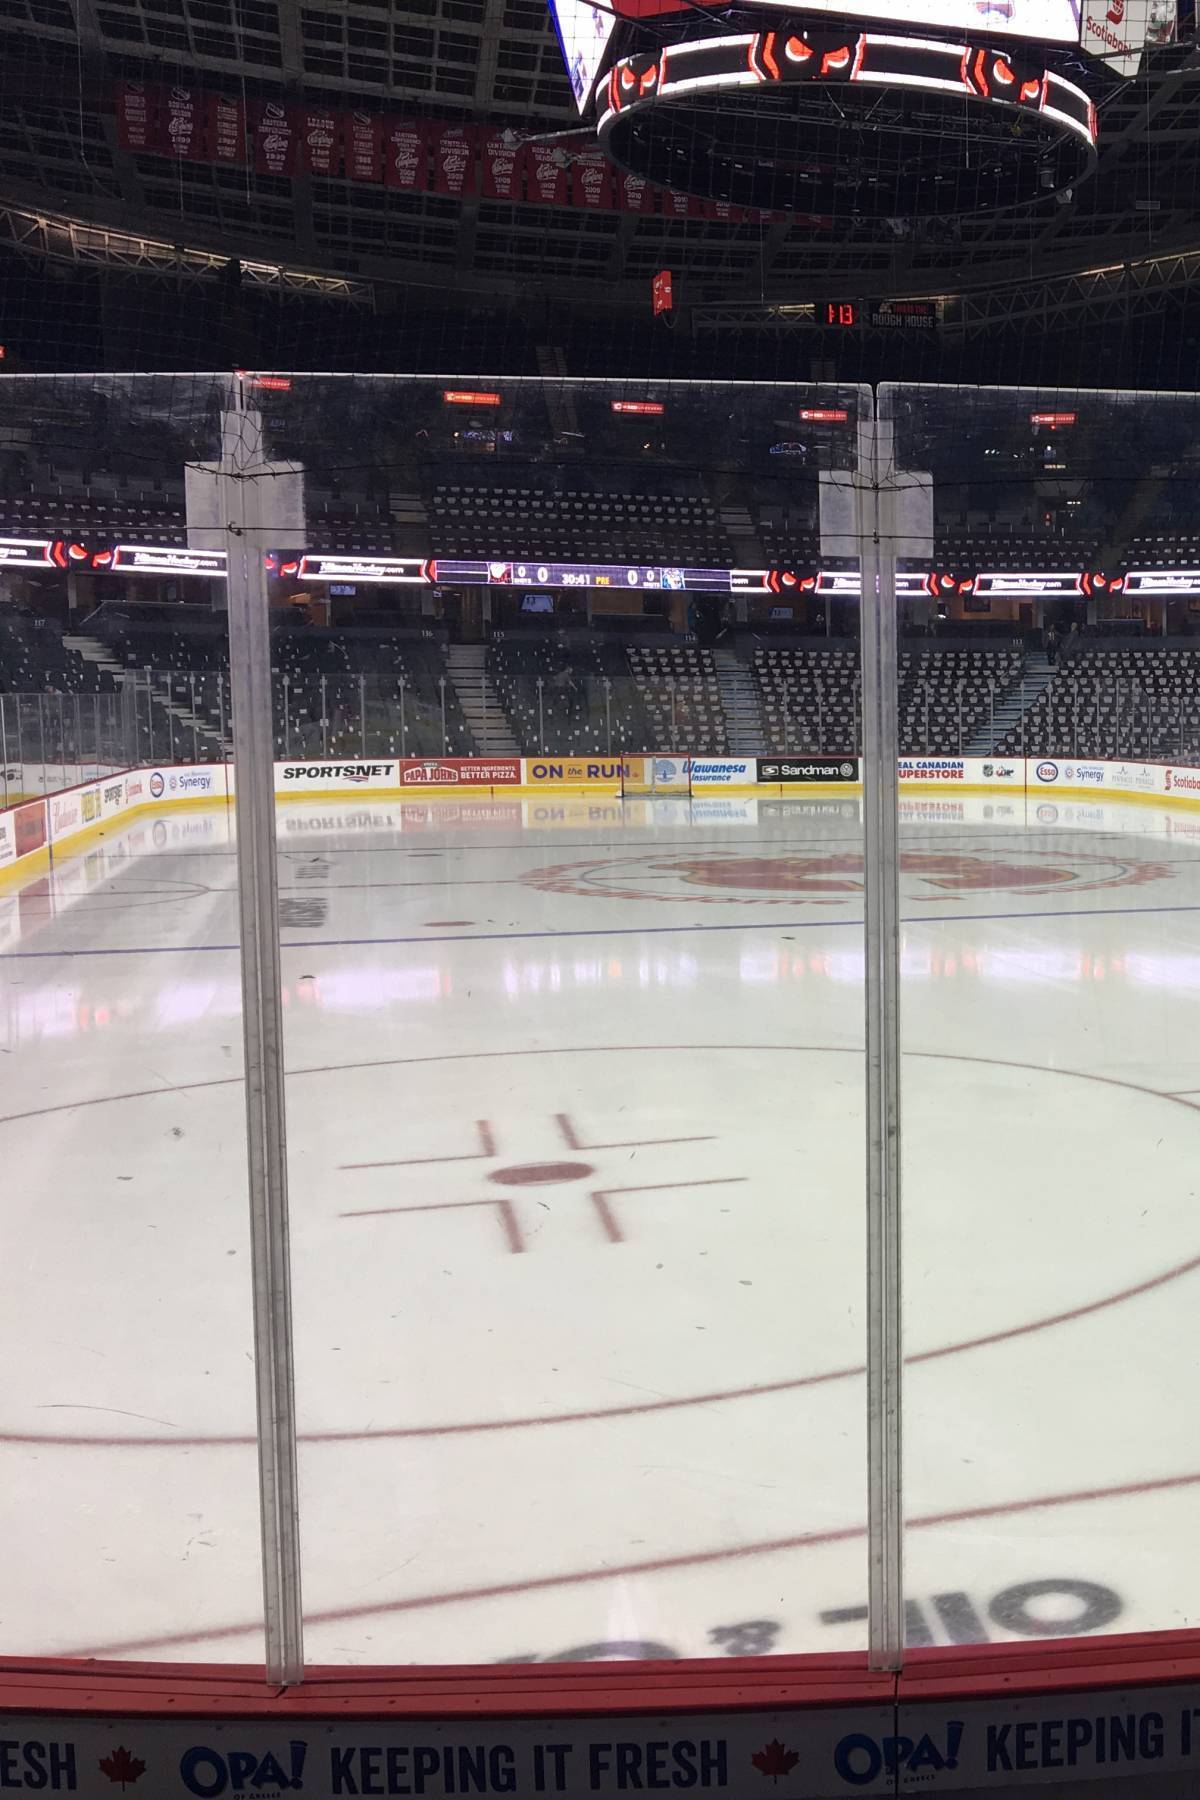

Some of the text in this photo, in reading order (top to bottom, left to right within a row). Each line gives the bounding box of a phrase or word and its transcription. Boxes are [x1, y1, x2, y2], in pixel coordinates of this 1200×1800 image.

[1087, 15, 1132, 60] Scotiabank
[872, 313, 935, 329] ROUGH HOUSE
[537, 566, 549, 583] 0
[561, 573, 591, 586] 30:41
[595, 577, 610, 586] PRE
[627, 569, 638, 585] 0
[283, 765, 394, 779] SPORTSNET
[532, 764, 630, 778] ON the RUN
[682, 761, 746, 773] Wawanesa
[781, 764, 839, 776] Sandman
[916, 761, 964, 769] CANADIAN
[460, 771, 517, 779] BETTER PIZZA.
[691, 773, 731, 781] Insurance
[899, 769, 964, 778] UPERSTORE
[1077, 767, 1104, 782] Synergy
[179, 777, 211, 789] Synergy
[834, 1720, 964, 1786] OPA!
[987, 1713, 1165, 1772] KEEPING
[0, 1741, 77, 1790] ESH
[180, 1739, 728, 1797] OPA! KEEPING IT FRESH
